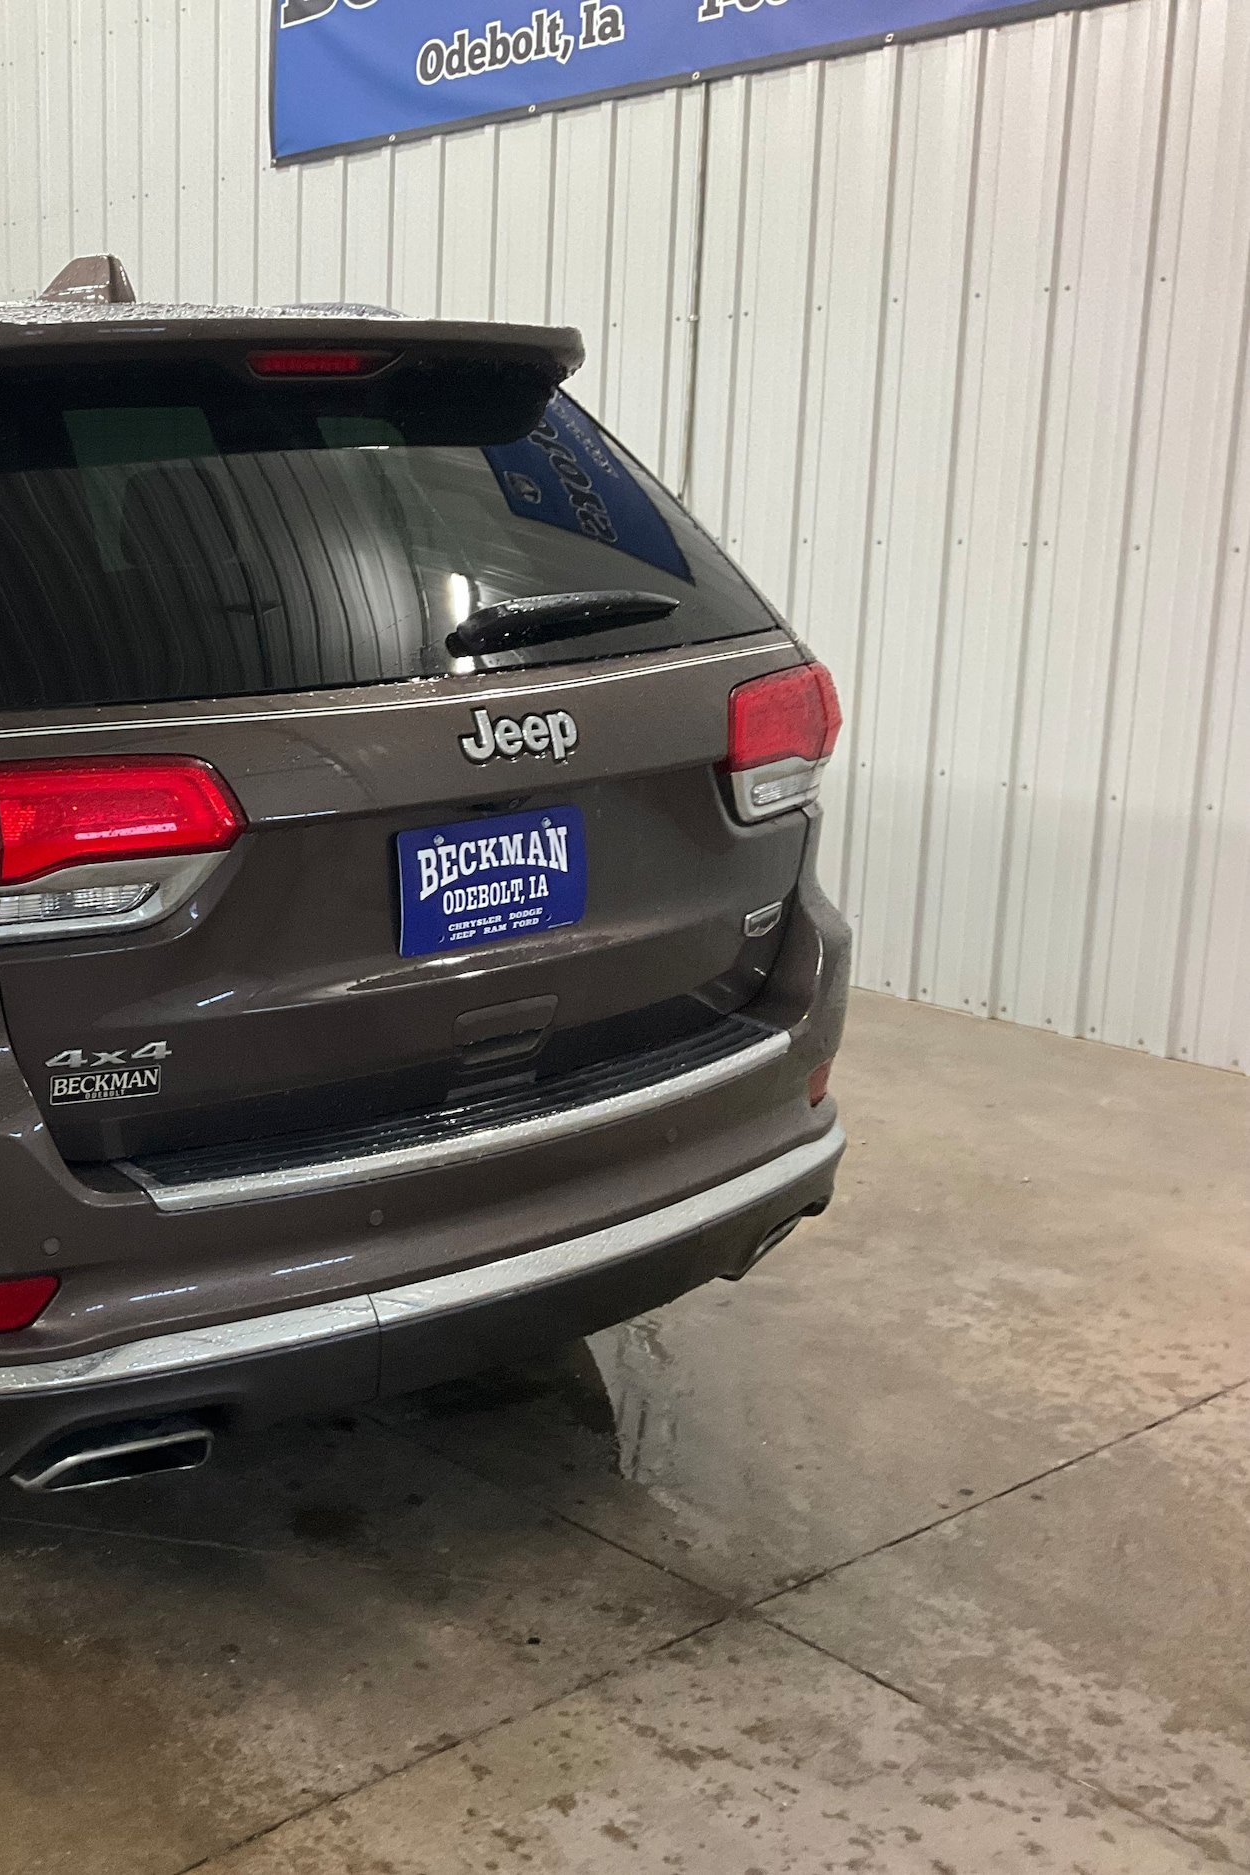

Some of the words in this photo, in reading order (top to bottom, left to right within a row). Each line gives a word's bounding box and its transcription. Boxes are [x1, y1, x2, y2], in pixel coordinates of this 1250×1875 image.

[417, 10, 574, 85] Odebolt,
[579, 0, 625, 49] Ia
[461, 708, 578, 760] Jeep
[417, 826, 568, 900] BECKMAN
[443, 878, 525, 915] ODEBOLT,
[529, 874, 549, 899] IA
[448, 915, 502, 932] CHRYSLER
[509, 907, 543, 920] DODGE
[449, 930, 476, 941] JEEP
[483, 924, 507, 934] RAM
[513, 917, 540, 929] FORD
[53, 1068, 159, 1096] BECKMAN
